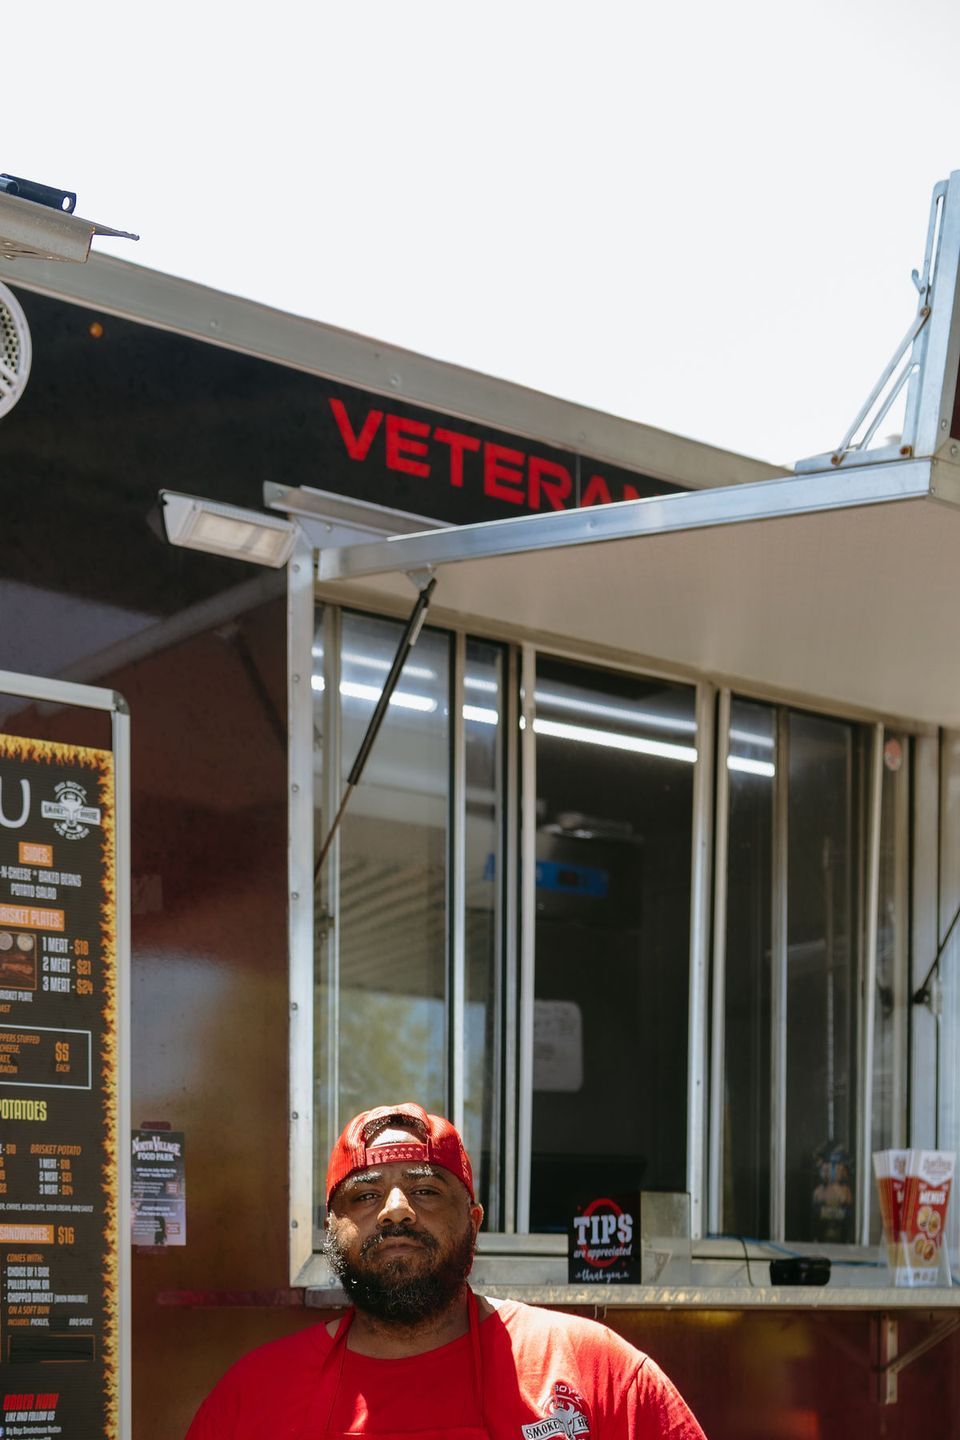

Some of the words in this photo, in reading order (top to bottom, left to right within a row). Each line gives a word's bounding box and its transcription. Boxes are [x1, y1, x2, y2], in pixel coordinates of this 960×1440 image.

[329, 398, 660, 511] VETERA
[39, 870, 59, 884] BAKED
[60, 873, 81, 887] BEANS
[11, 883, 34, 897] POTATO
[36, 886, 56, 900] SALAD
[31, 911, 61, 928] PLATES:
[48, 937, 68, 953] MEAT
[42, 956, 49, 971] 2
[50, 957, 71, 973] MEAT
[42, 976, 49, 991] 3
[50, 977, 71, 992] MEAT
[56, 1064, 70, 1072] EACH
[30, 1144, 56, 1154] BRISKET
[57, 1145, 81, 1155] POTATO
[138, 1152, 155, 1161] FOOD
[156, 1152, 174, 1161] PARK
[43, 1159, 56, 1169] MEAT
[44, 1172, 58, 1182] MEAT
[44, 1184, 58, 1195] MEAT
[58, 1226, 74, 1245] $16
[574, 1214, 633, 1245] TIPS
[7, 1254, 26, 1262] COMES
[574, 1249, 585, 1258] are
[587, 1245, 632, 1260] appreciated
[7, 1266, 26, 1277] CHOICE
[27, 1267, 33, 1277] OF
[38, 1267, 49, 1277] SIDE
[7, 1280, 26, 1290] PULLED
[27, 1280, 41, 1290] PORK
[8, 1293, 31, 1303] CHOPPED
[32, 1293, 53, 1303] BRISKET
[8, 1306, 17, 1314] ON
[18, 1306, 22, 1314] A
[23, 1306, 36, 1314] SOFT
[37, 1306, 50, 1314] BUN
[3, 1394, 34, 1410] ORDER
[35, 1393, 59, 1409] NOW
[526, 1421, 559, 1439] SMOKE
